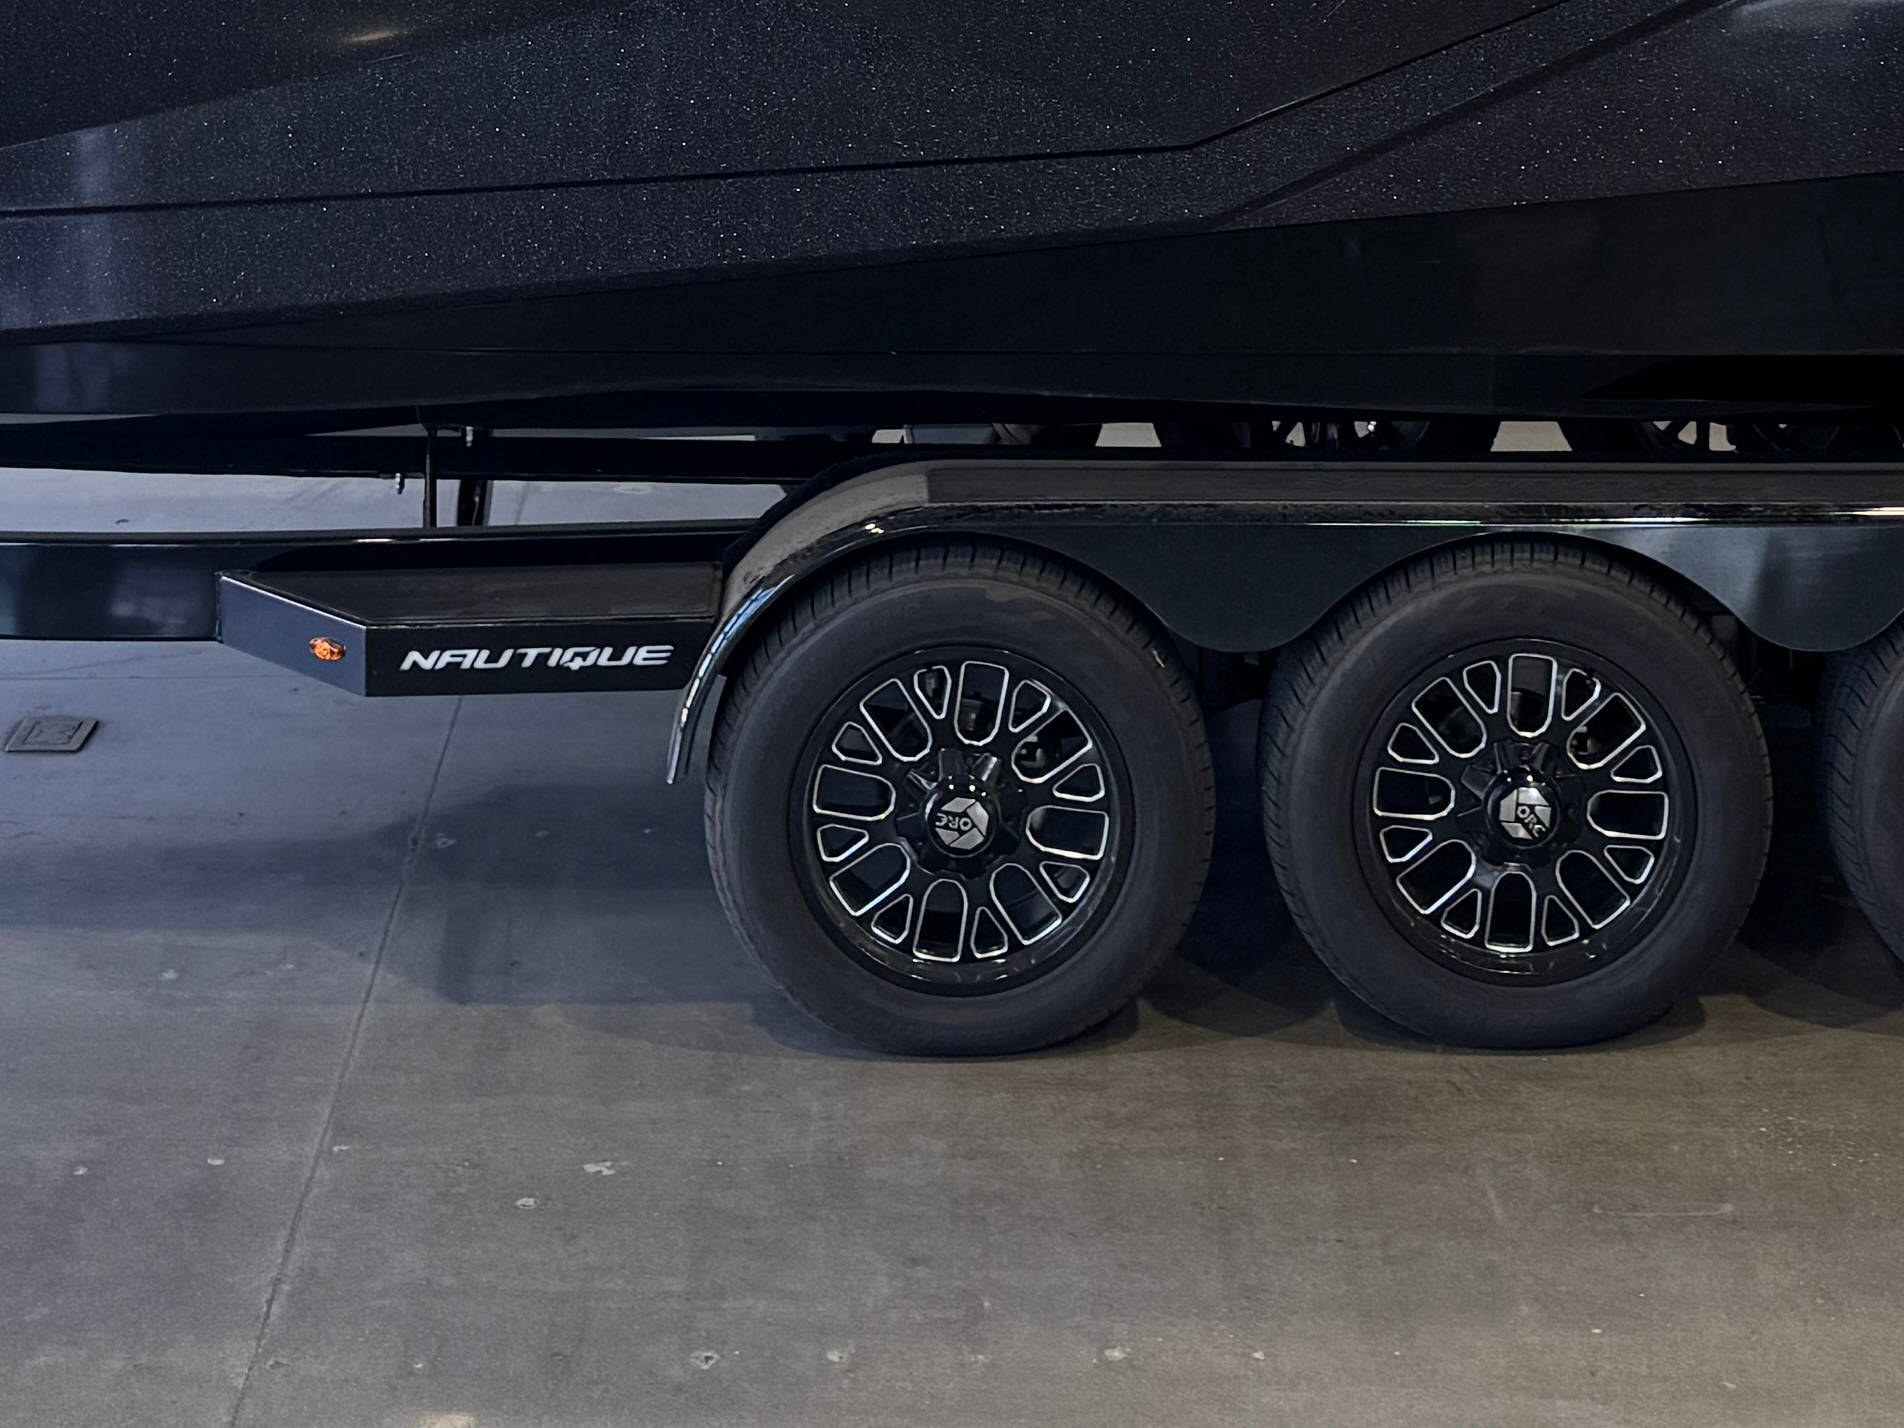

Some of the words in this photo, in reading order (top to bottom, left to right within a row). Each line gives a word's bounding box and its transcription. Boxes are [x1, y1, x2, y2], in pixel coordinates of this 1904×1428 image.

[399, 644, 675, 672] NAUTIQUE
[935, 812, 973, 832] ORC
[1516, 805, 1547, 838] ORC
